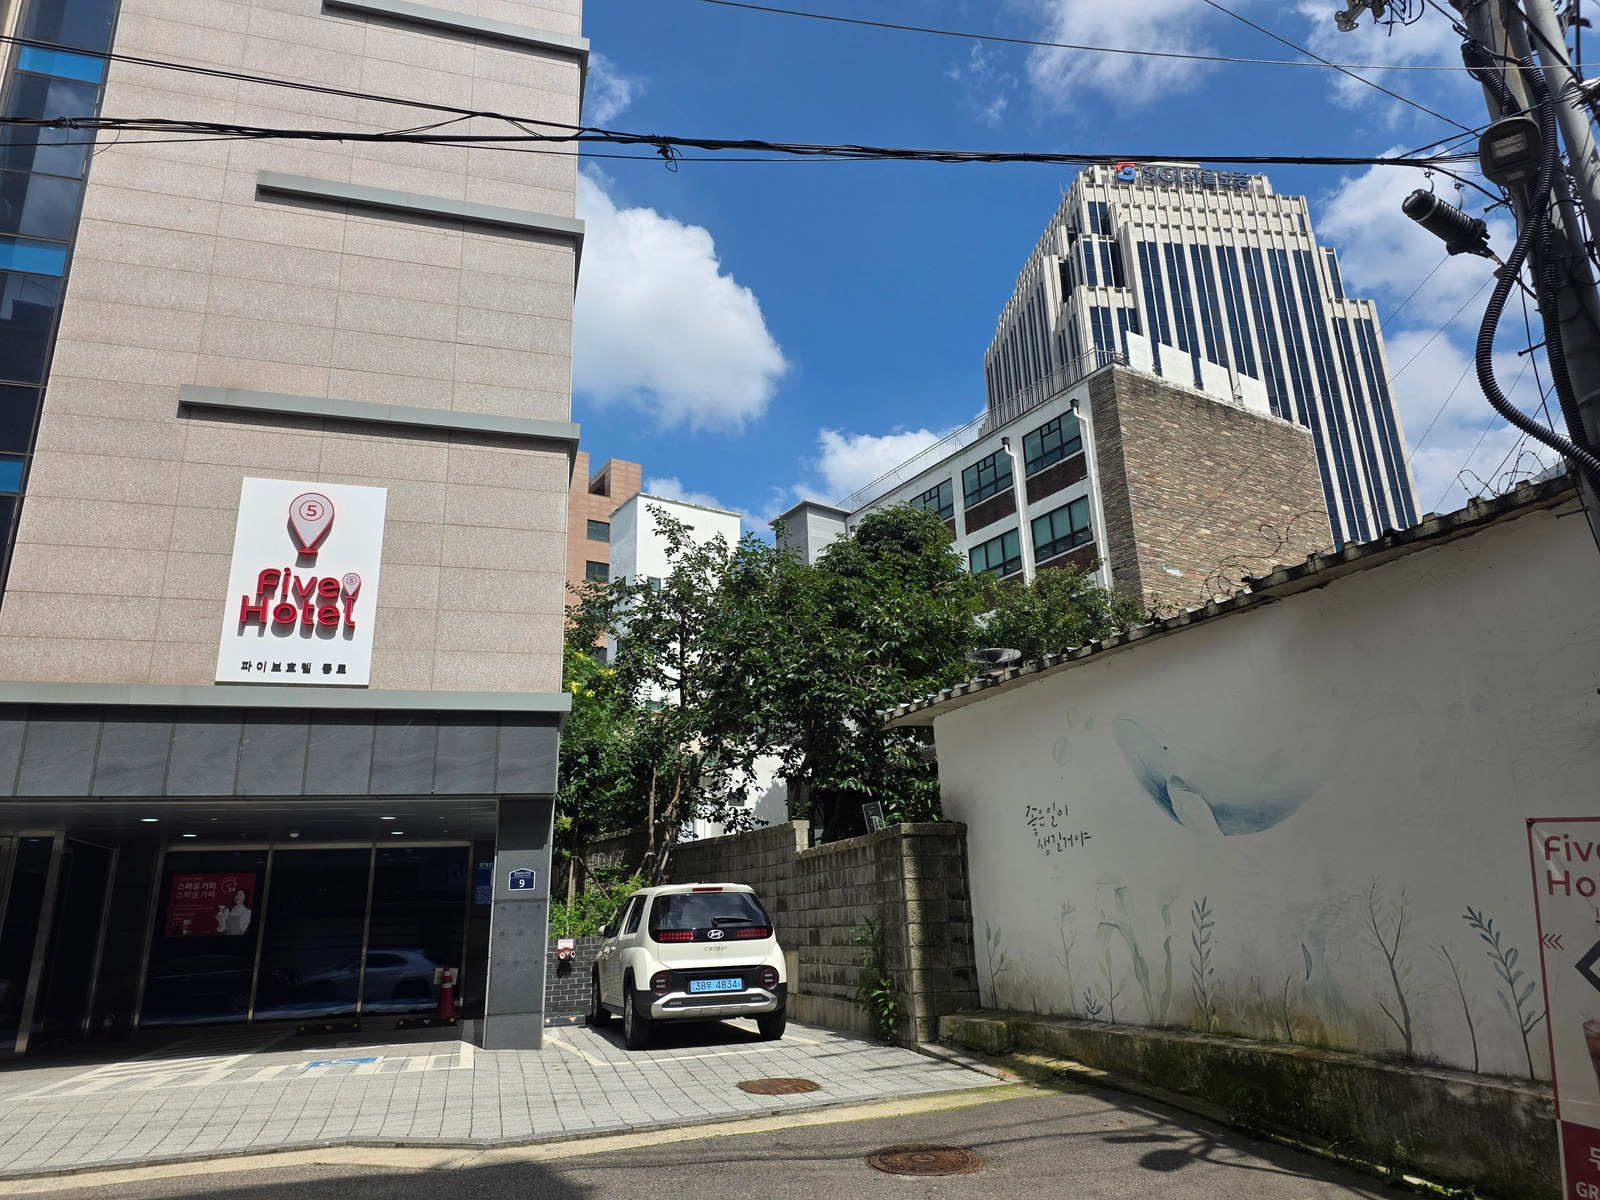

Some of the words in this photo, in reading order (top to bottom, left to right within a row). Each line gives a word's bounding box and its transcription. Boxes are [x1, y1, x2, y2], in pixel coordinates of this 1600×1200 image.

[306, 504, 318, 517] 5
[256, 567, 341, 598] Five
[239, 592, 356, 627] Hotel
[241, 661, 312, 674] 파이브호텔
[1544, 833, 1600, 862] Fiv
[177, 882, 200, 890] 스페셜
[201, 881, 216, 890] 커피
[519, 879, 525, 888] 9
[1546, 870, 1600, 898] Ho
[176, 891, 199, 899] 스페셜
[716, 979, 738, 989] 4834
